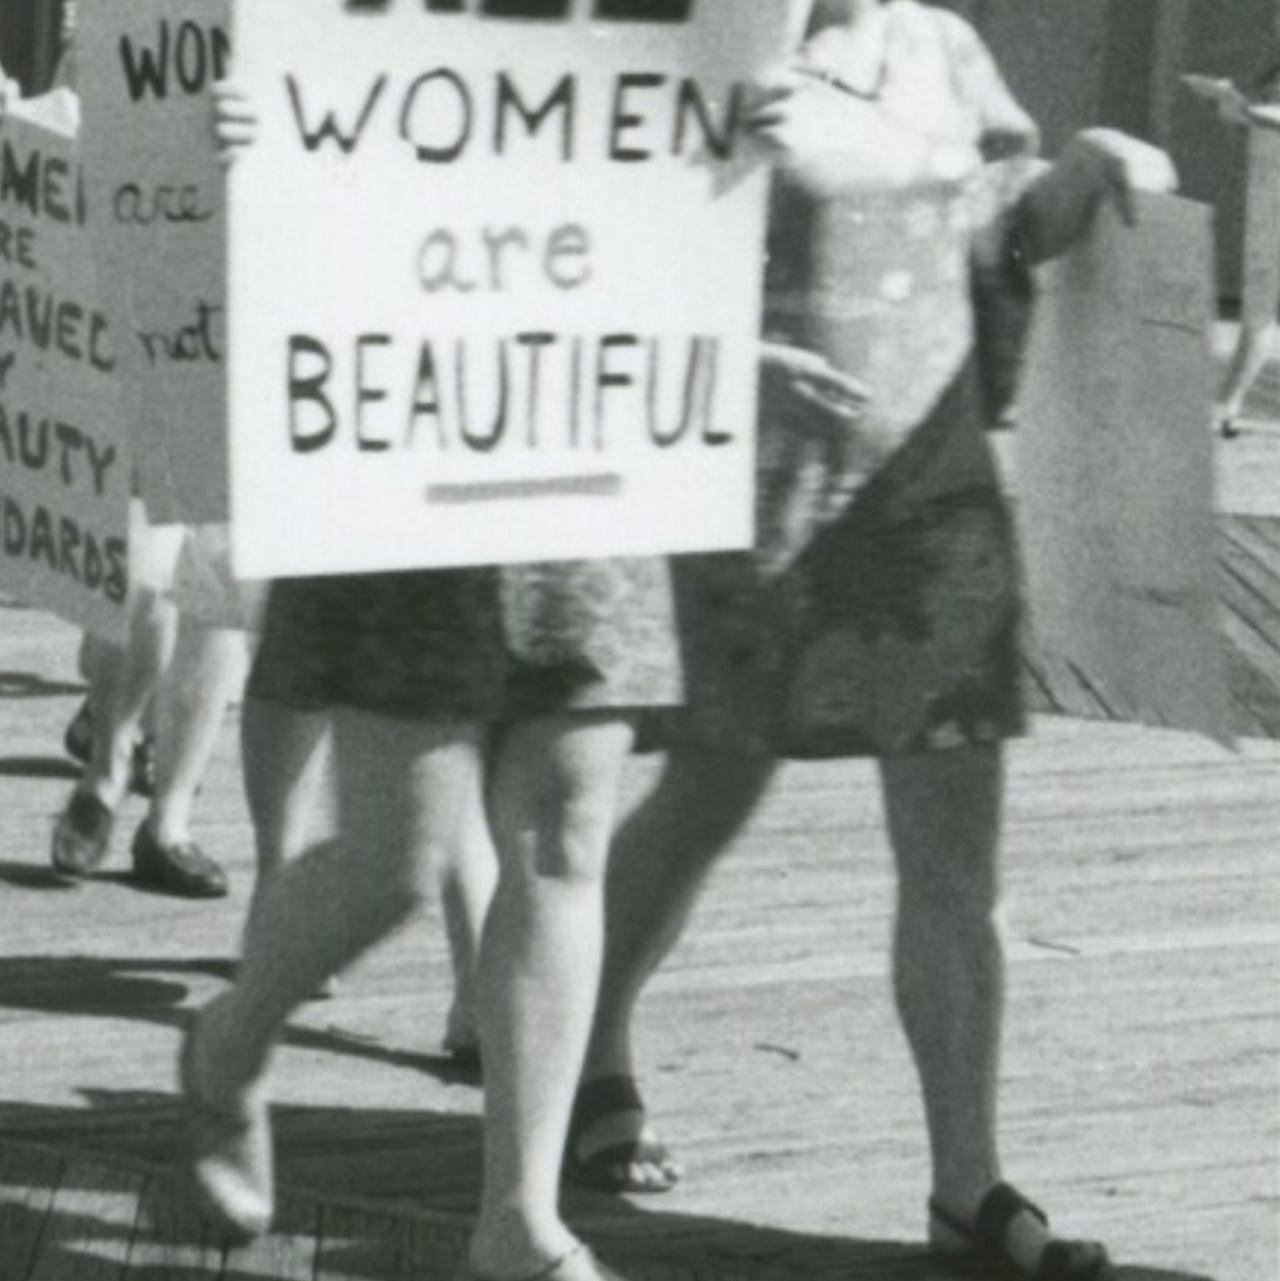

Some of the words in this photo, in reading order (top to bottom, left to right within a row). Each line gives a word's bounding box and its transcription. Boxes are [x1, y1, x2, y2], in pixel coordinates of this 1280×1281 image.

[285, 68, 746, 163] WOMEN
[113, 182, 214, 225] are
[415, 221, 594, 293] are
[286, 332, 736, 454] BEAUTIFUL
